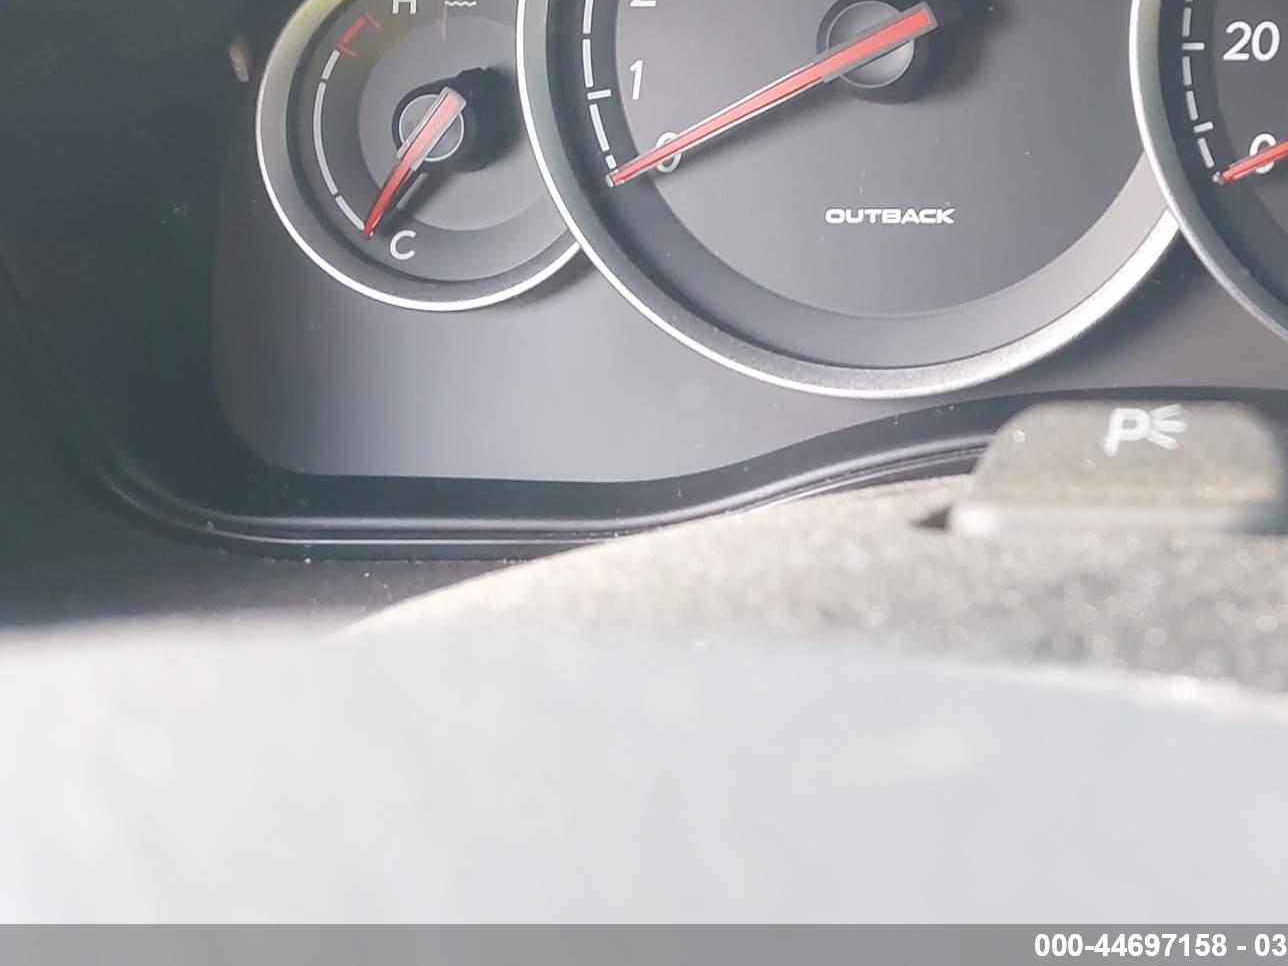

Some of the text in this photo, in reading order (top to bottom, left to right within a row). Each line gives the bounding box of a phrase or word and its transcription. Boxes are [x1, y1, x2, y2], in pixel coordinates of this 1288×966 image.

[1223, 22, 1279, 61] 20
[630, 60, 642, 99] 1
[655, 132, 682, 173] 0
[1250, 133, 1277, 175] 0
[826, 209, 954, 224] OUTBACK
[390, 230, 416, 260] C
[1104, 407, 1151, 456] P
